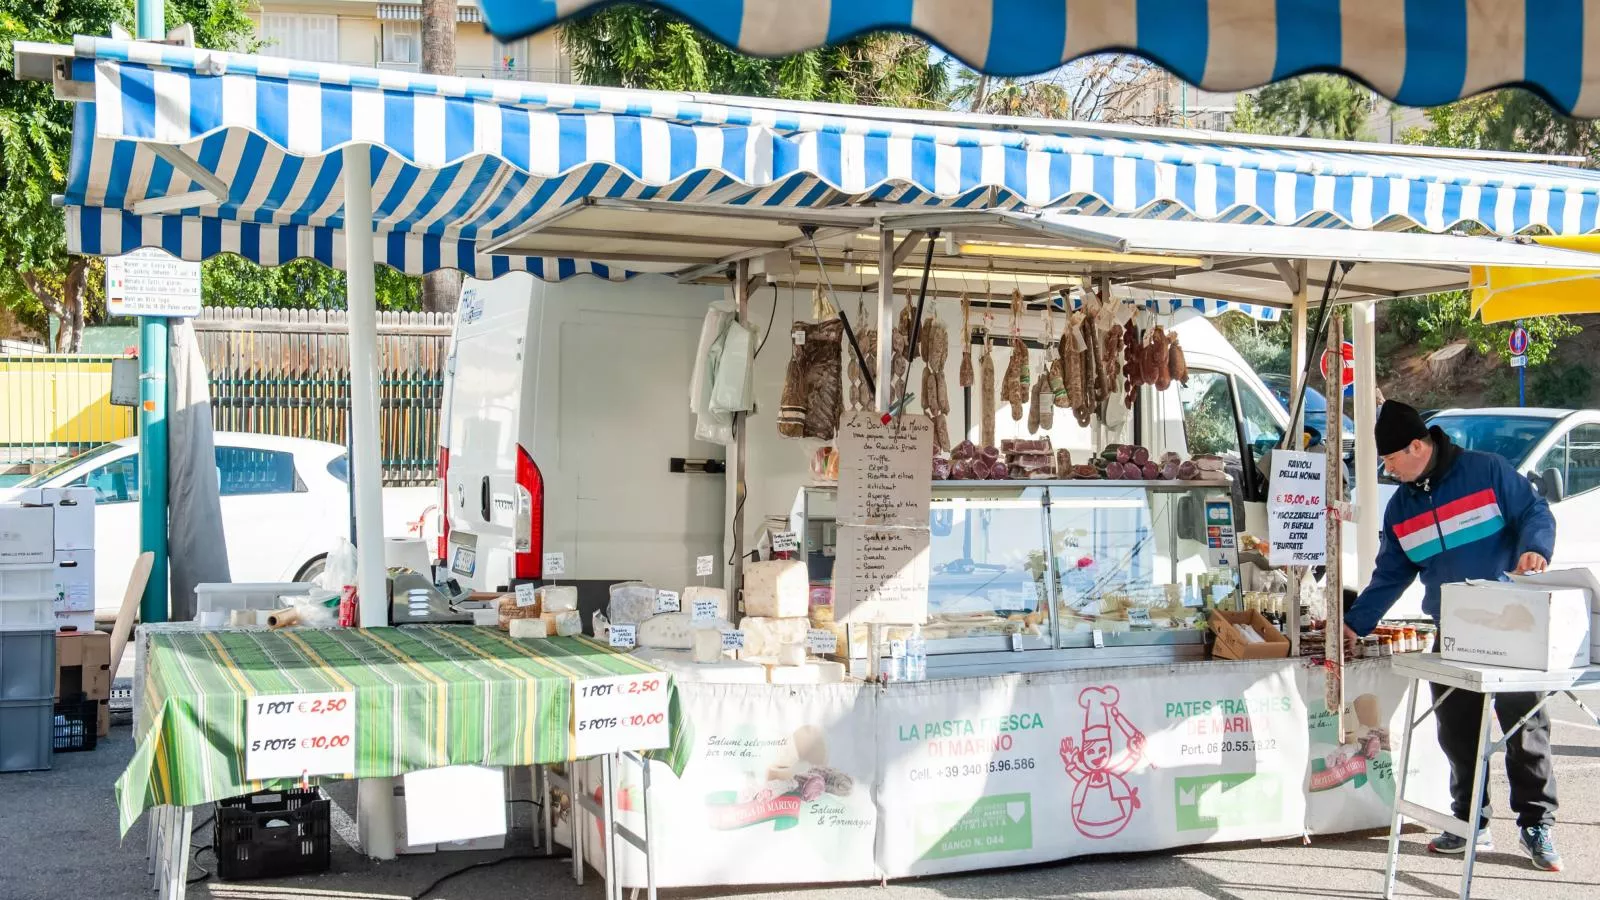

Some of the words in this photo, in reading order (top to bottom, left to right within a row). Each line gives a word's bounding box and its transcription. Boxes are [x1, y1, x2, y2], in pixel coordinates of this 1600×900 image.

[847, 415, 861, 428] La
[1288, 460, 1312, 469] RAVIOLI
[1279, 470, 1297, 478] DELLA
[1299, 472, 1321, 480] NONNA
[1284, 495, 1305, 504] 18,00
[1310, 496, 1320, 505] KG
[582, 687, 588, 697] 1
[590, 683, 614, 696] POT
[628, 680, 659, 694] 2,50
[257, 703, 264, 714] 1
[267, 701, 294, 714] POT
[311, 699, 346, 714] 2,50
[1165, 700, 1212, 718] PATES
[579, 720, 587, 730] 5
[589, 717, 617, 730] POTS
[899, 724, 920, 741] LA
[924, 719, 974, 740] PASTA
[980, 713, 1044, 733] FRESCA
[1187, 719, 1207, 735] DE
[252, 740, 261, 751] 5
[264, 738, 296, 751] POTS
[707, 736, 741, 747] Salumi
[928, 741, 943, 757] DI
[948, 734, 1013, 757] MARINO
[1181, 744, 1204, 755] Port.
[910, 769, 932, 781] Cell.
[962, 764, 981, 777] 340
[766, 799, 798, 812] MARINO
[809, 802, 846, 815] Salumi
[828, 816, 872, 829] Formaggi
